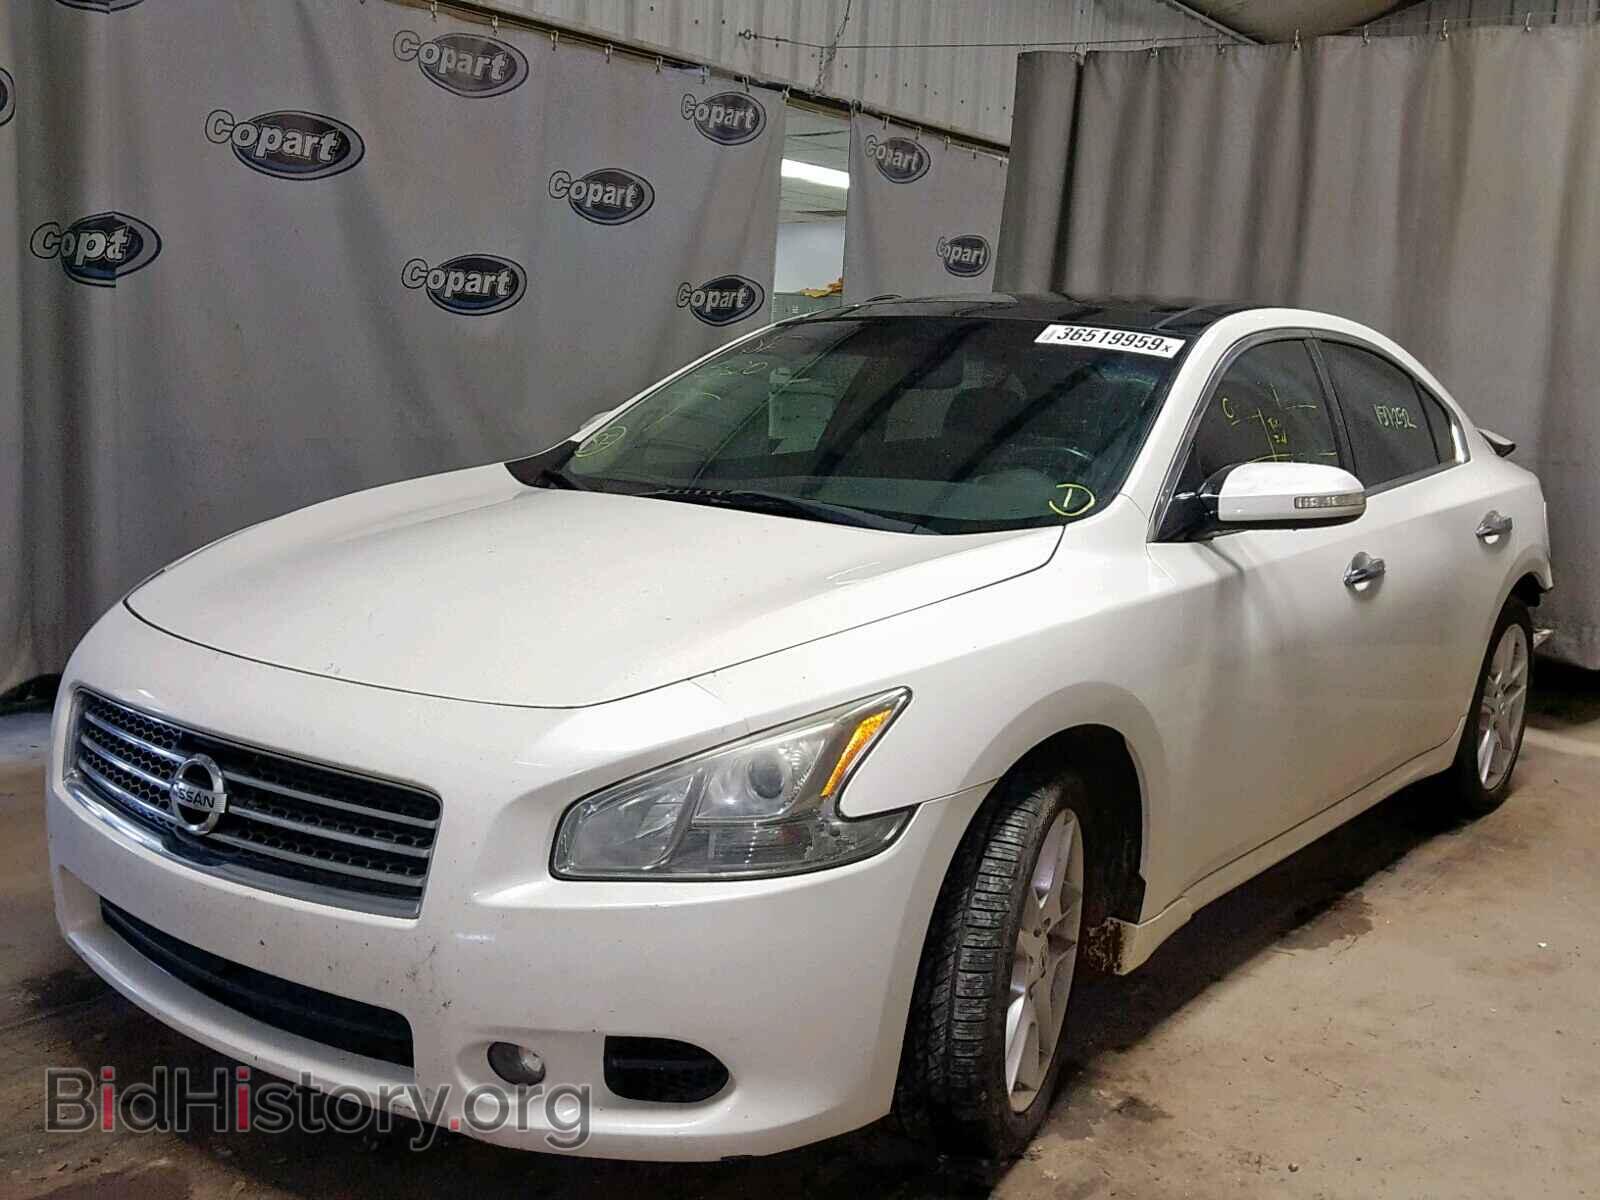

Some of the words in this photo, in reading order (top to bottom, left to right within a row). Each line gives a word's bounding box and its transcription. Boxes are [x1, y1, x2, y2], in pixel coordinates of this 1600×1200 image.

[393, 30, 510, 81] Copart
[680, 94, 755, 131] Copart
[205, 109, 342, 162] Copart
[864, 135, 919, 171] Copart
[548, 170, 640, 209] Copart
[936, 236, 985, 264] Copart
[402, 258, 511, 297] Copart
[676, 281, 748, 310] Copart
[1057, 327, 1164, 351] 36519959
[173, 783, 216, 809] SSAN
